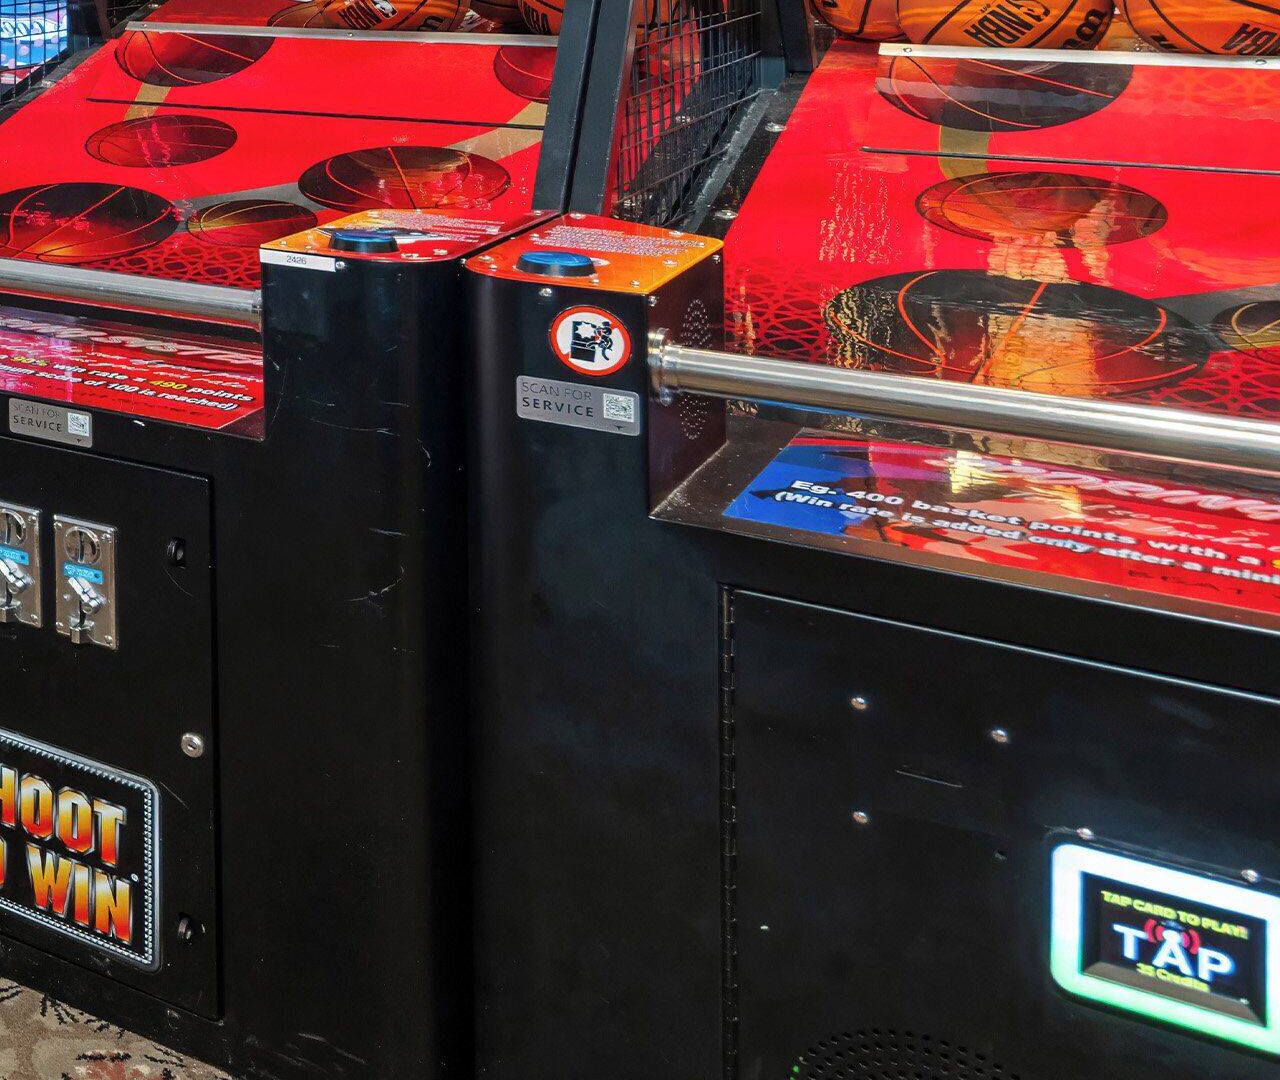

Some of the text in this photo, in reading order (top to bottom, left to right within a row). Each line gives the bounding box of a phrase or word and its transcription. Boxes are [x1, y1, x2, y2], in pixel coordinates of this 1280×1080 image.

[1221, 23, 1280, 56] BA
[286, 255, 308, 266] 2426
[35, 371, 83, 384] score
[83, 378, 104, 387] of
[107, 382, 140, 394] 100
[139, 388, 156, 397] is
[156, 391, 240, 411] reached)
[88, 371, 129, 381] rate
[149, 380, 188, 390] 490
[186, 386, 255, 402] points
[521, 381, 592, 400] SCAN FOR
[13, 415, 62, 433] SERVICE
[522, 397, 594, 418] SERVICE
[774, 491, 1280, 585] (Win rate is added only after a mini
[846, 490, 904, 506] 400
[911, 499, 1025, 526] basket
[1028, 521, 1138, 545] points
[1146, 539, 1230, 560] with
[1236, 555, 1264, 566] a
[26, 841, 133, 944] WIN
[1101, 890, 1132, 907] TAP
[1132, 899, 1178, 920] CARD
[1177, 910, 1200, 927] TO
[1112, 923, 1236, 983] TAP
